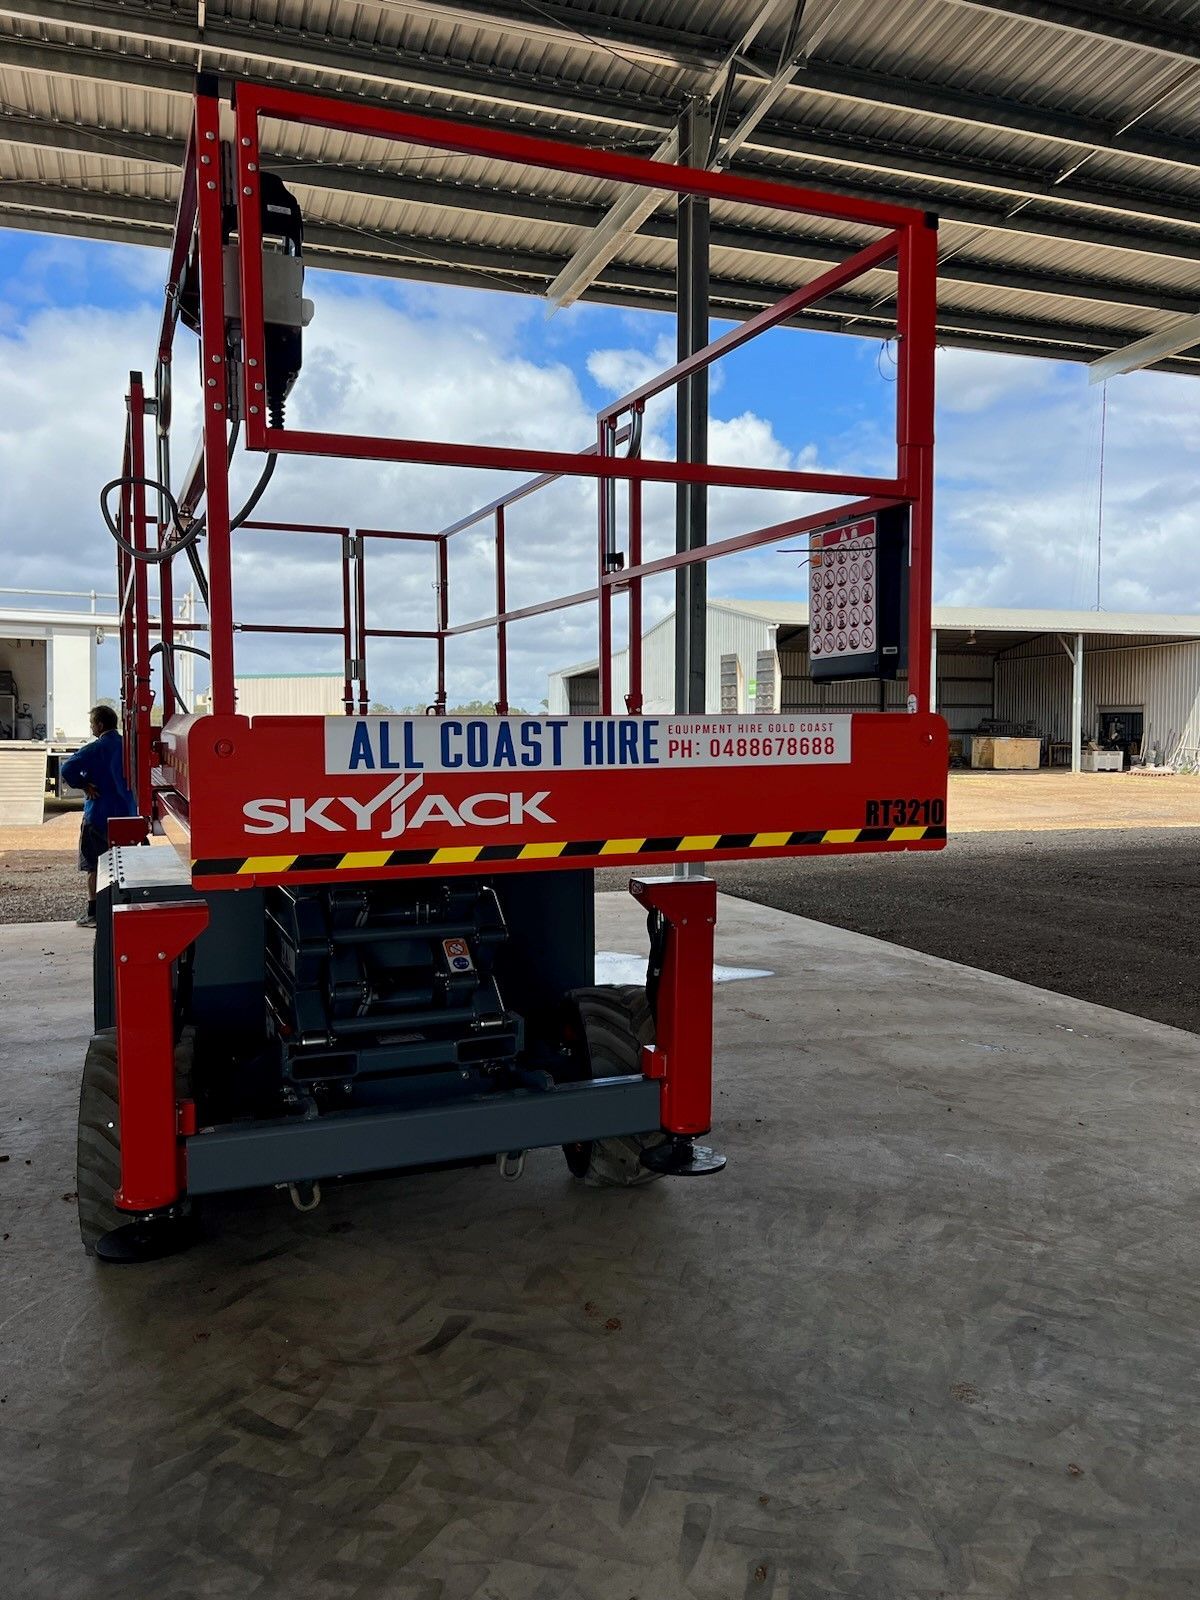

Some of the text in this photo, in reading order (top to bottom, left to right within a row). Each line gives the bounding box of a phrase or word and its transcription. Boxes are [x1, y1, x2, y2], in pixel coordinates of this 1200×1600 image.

[668, 722, 834, 734] EQUIPMENT HIRE GOLD COAST
[348, 720, 660, 769] ALL COAST HIRE
[668, 737, 836, 759] PH: 0488678688
[242, 773, 557, 839] SKYJACK
[865, 799, 944, 826] RT3210
